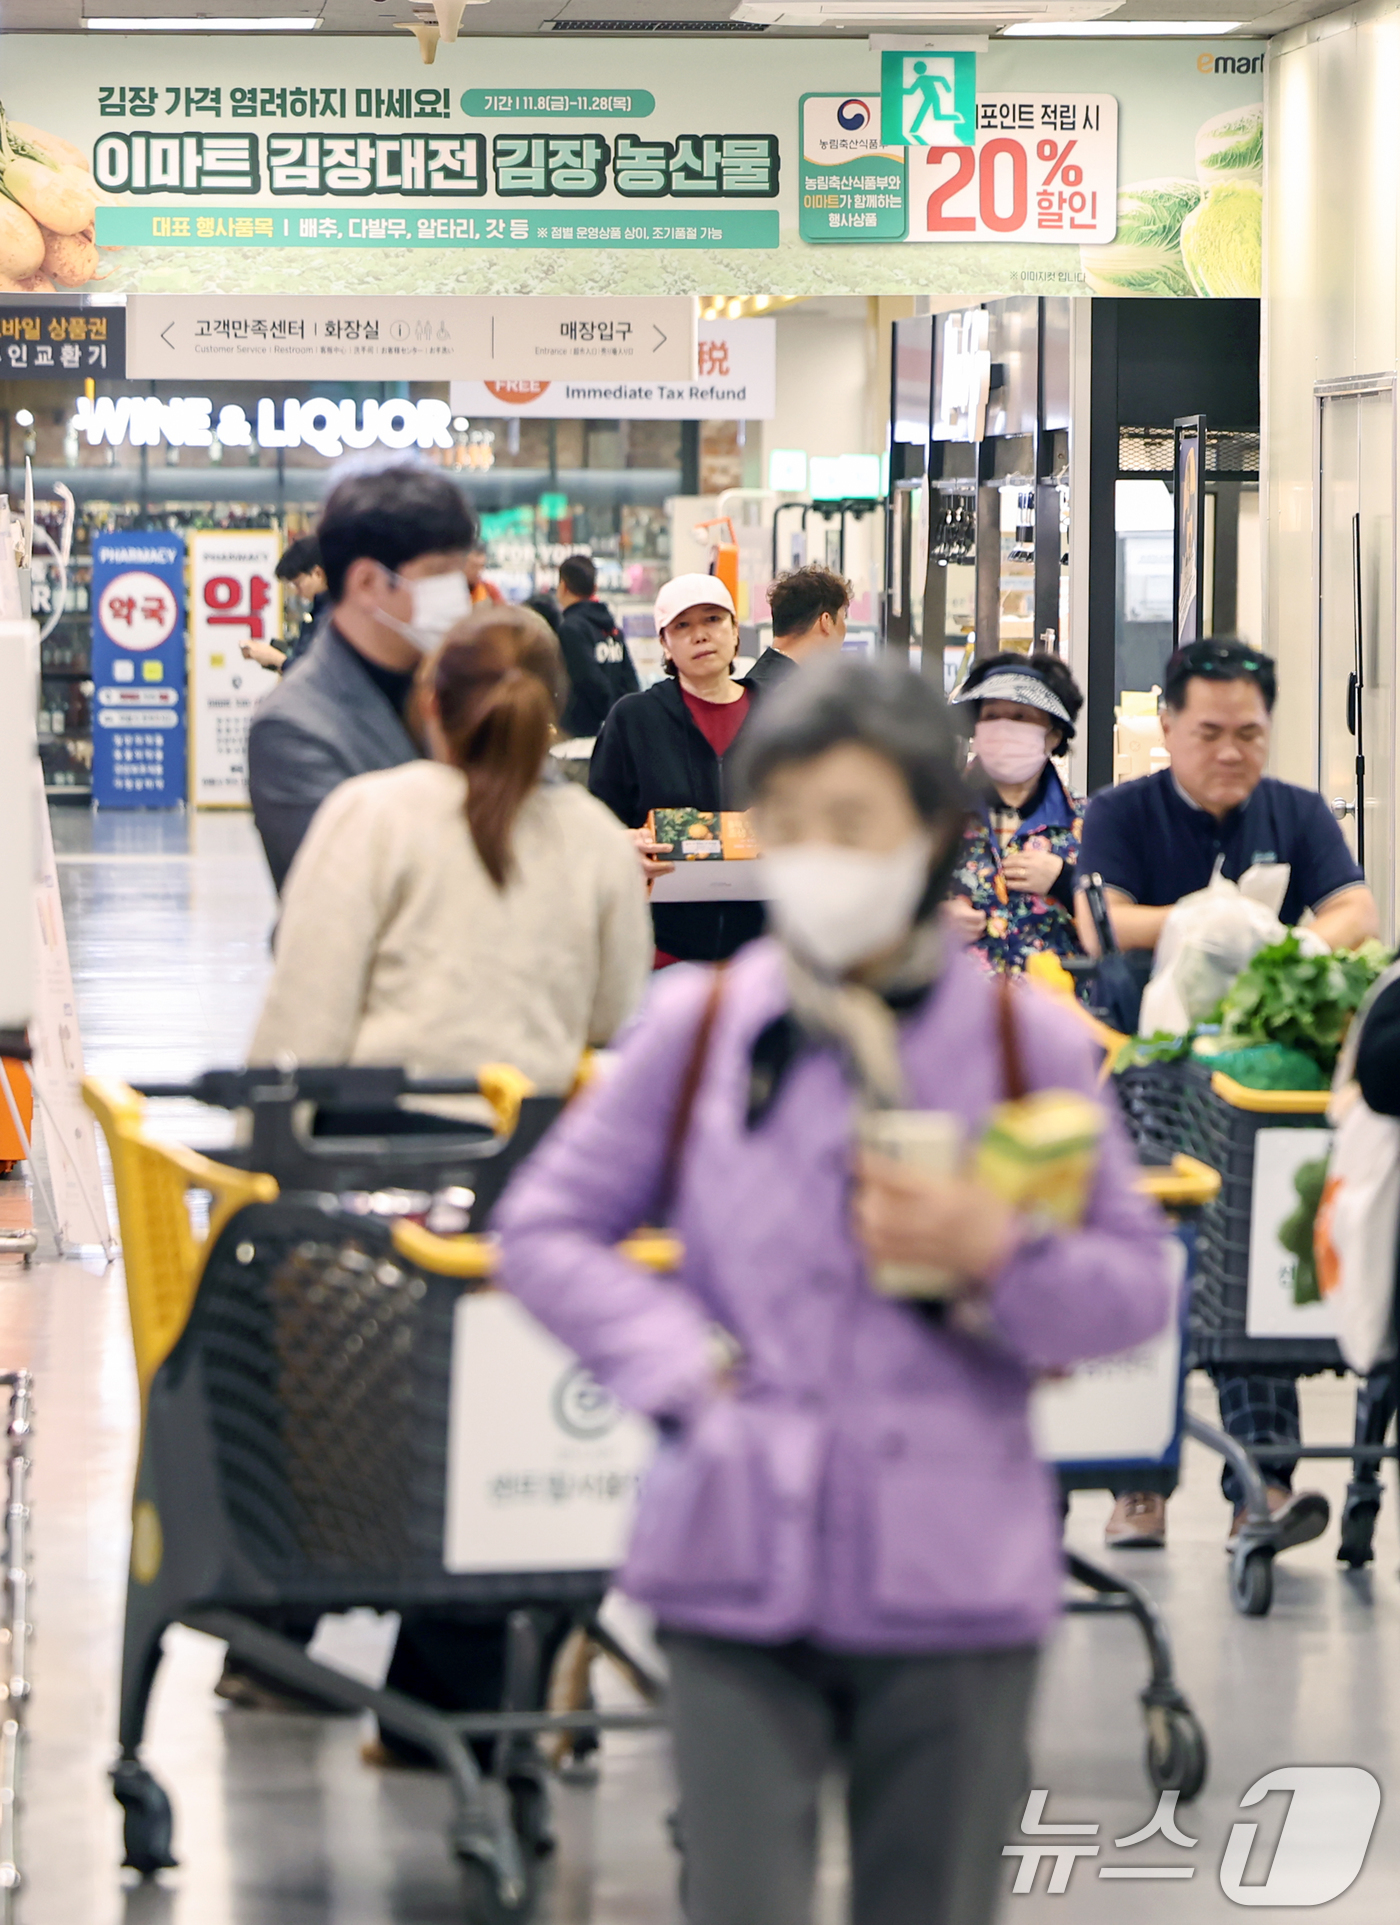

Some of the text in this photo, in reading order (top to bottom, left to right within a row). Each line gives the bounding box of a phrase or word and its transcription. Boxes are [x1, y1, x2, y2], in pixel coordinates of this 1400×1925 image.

[98, 87, 450, 119] 김장 가격 염려하지 마세요!
[484, 96, 513, 111] 기간
[975, 103, 1100, 131] 포인트 적립 시
[94, 133, 776, 195] 이마트 김장대전 김장 농산물
[805, 175, 901, 191] 농림축산식품부와
[804, 194, 902, 209] 이마트가 함께하는
[1036, 189, 1097, 229] 할인
[152, 216, 529, 240] 대표 행사품목 배추, 다발무, 알타리, 갓 등
[828, 212, 878, 228] 행사상품
[551, 226, 574, 240] 점별
[576, 226, 622, 240] 운영상품
[652, 226, 698, 240] 조기품절
[700, 227, 723, 240] 가능
[1020, 271, 1056, 282] 이미지컷
[1058, 272, 1086, 283] 입니다
[0, 317, 107, 341] 바일 상품권
[194, 319, 379, 340] 고객만족센터 화장실
[560, 320, 633, 341] 매장입구
[0, 343, 107, 369] 인교환기
[194, 345, 314, 354] Customer Service Restroom
[535, 347, 567, 356] Entrance
[496, 380, 541, 392] FREE
[566, 385, 747, 401] Immediate Tax Refund
[75, 396, 213, 447] WINE
[257, 397, 454, 457] LIQUOR
[100, 546, 177, 565] PHARMACY
[203, 552, 269, 562] PHARMACY
[203, 575, 270, 639] 약
